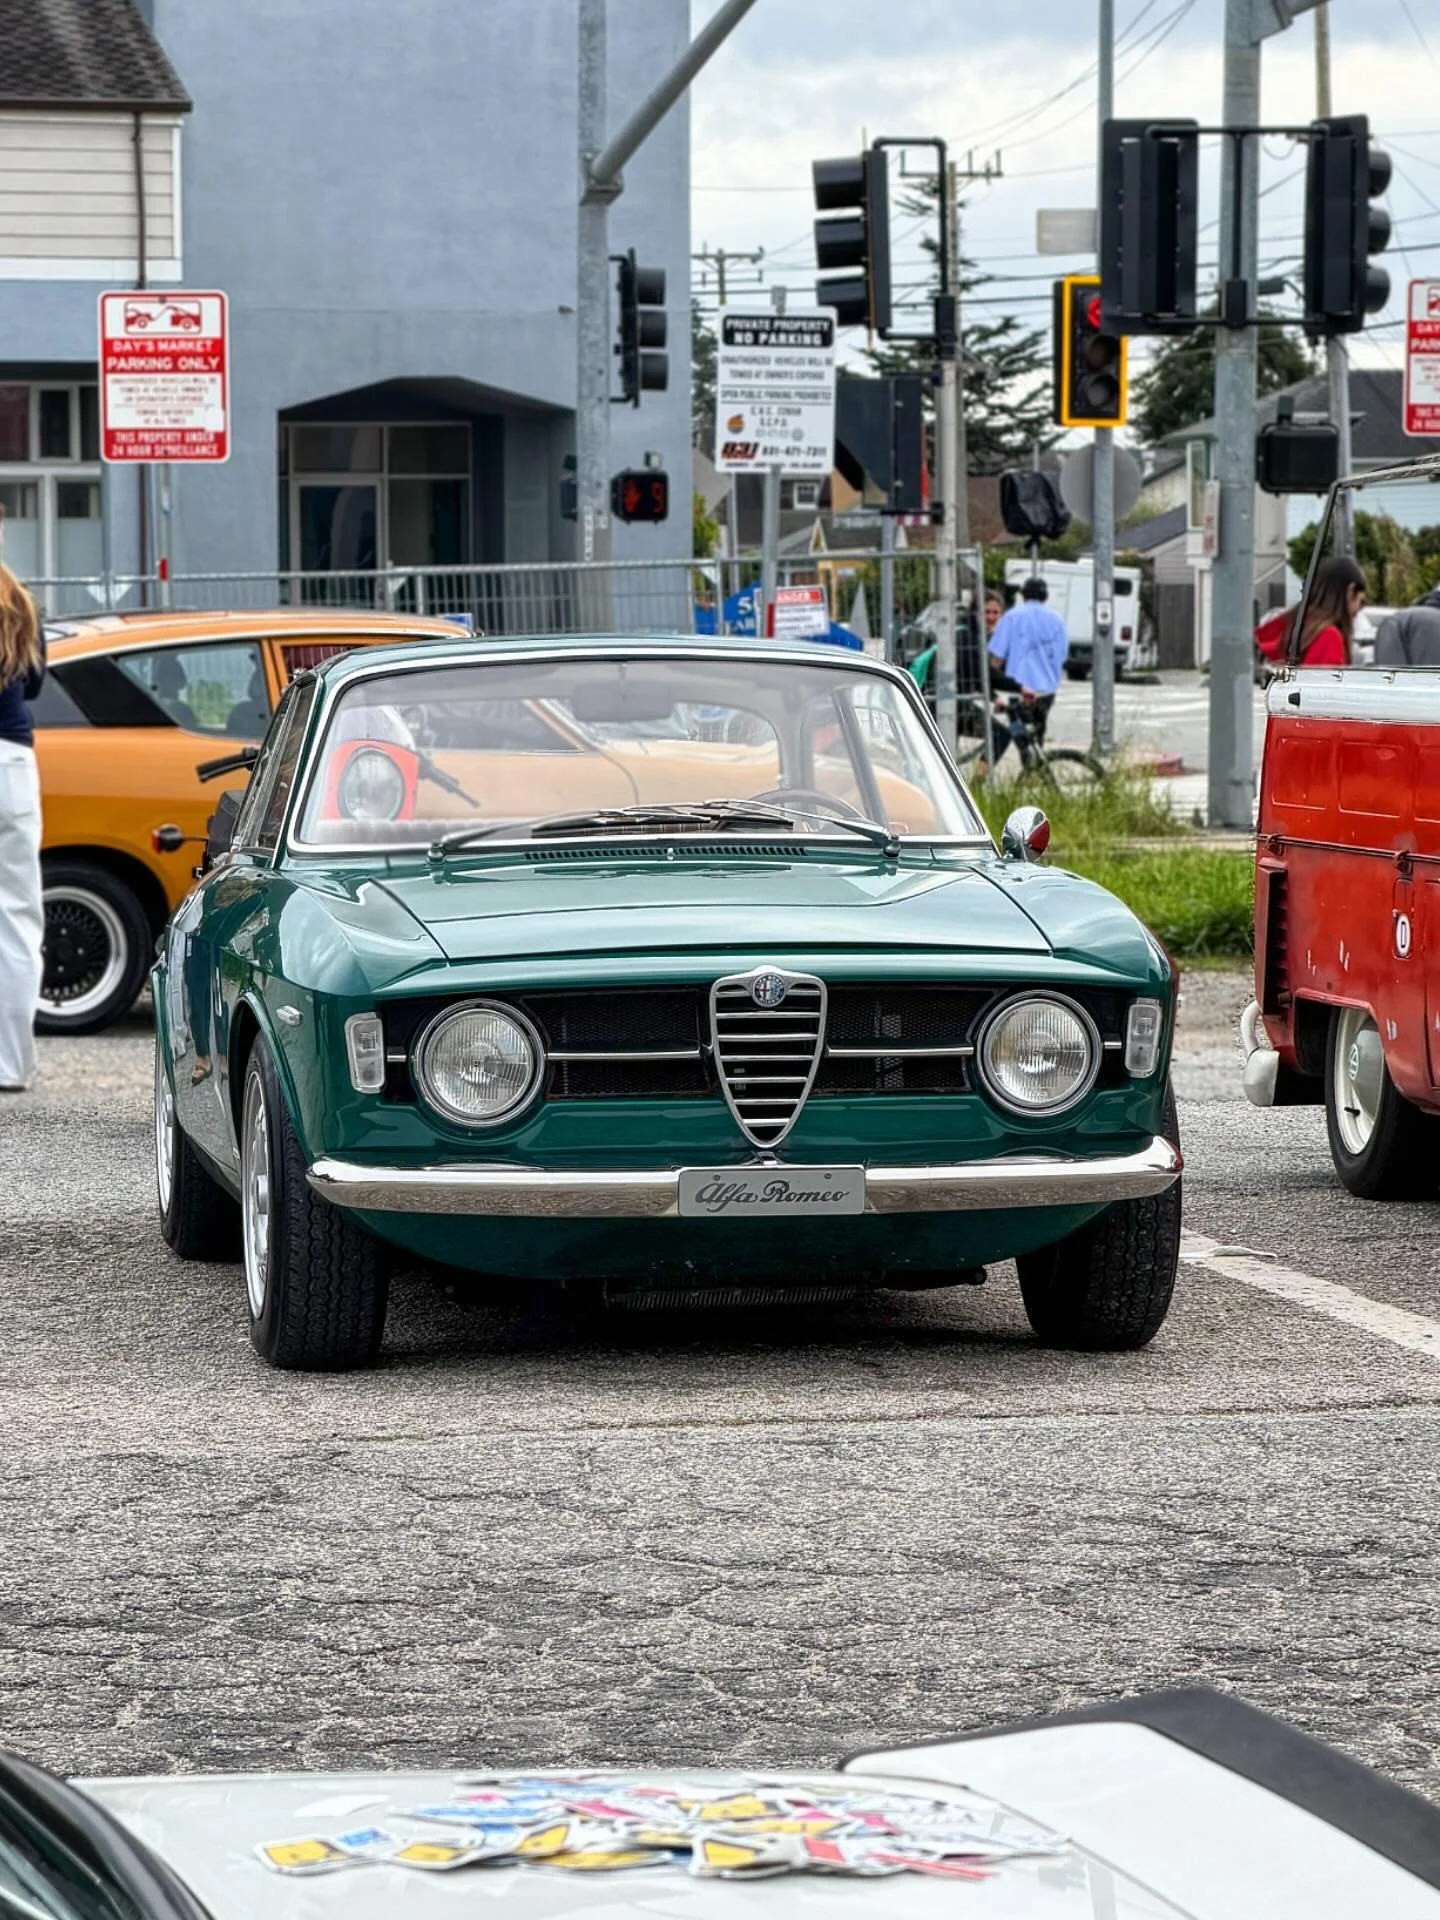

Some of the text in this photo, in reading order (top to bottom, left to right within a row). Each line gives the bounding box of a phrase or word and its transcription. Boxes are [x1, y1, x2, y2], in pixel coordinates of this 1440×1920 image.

[726, 318, 829, 332] PRIVATE PROPERTY
[733, 332, 822, 345] NO PARKING
[112, 340, 213, 353] DAY'S MARKET
[107, 356, 220, 370] PARKING ONLY
[115, 432, 136, 444] THIS
[137, 432, 182, 444] PROPERTY
[112, 444, 124, 456] 24
[695, 1179, 850, 1213] Alfa Romeo
